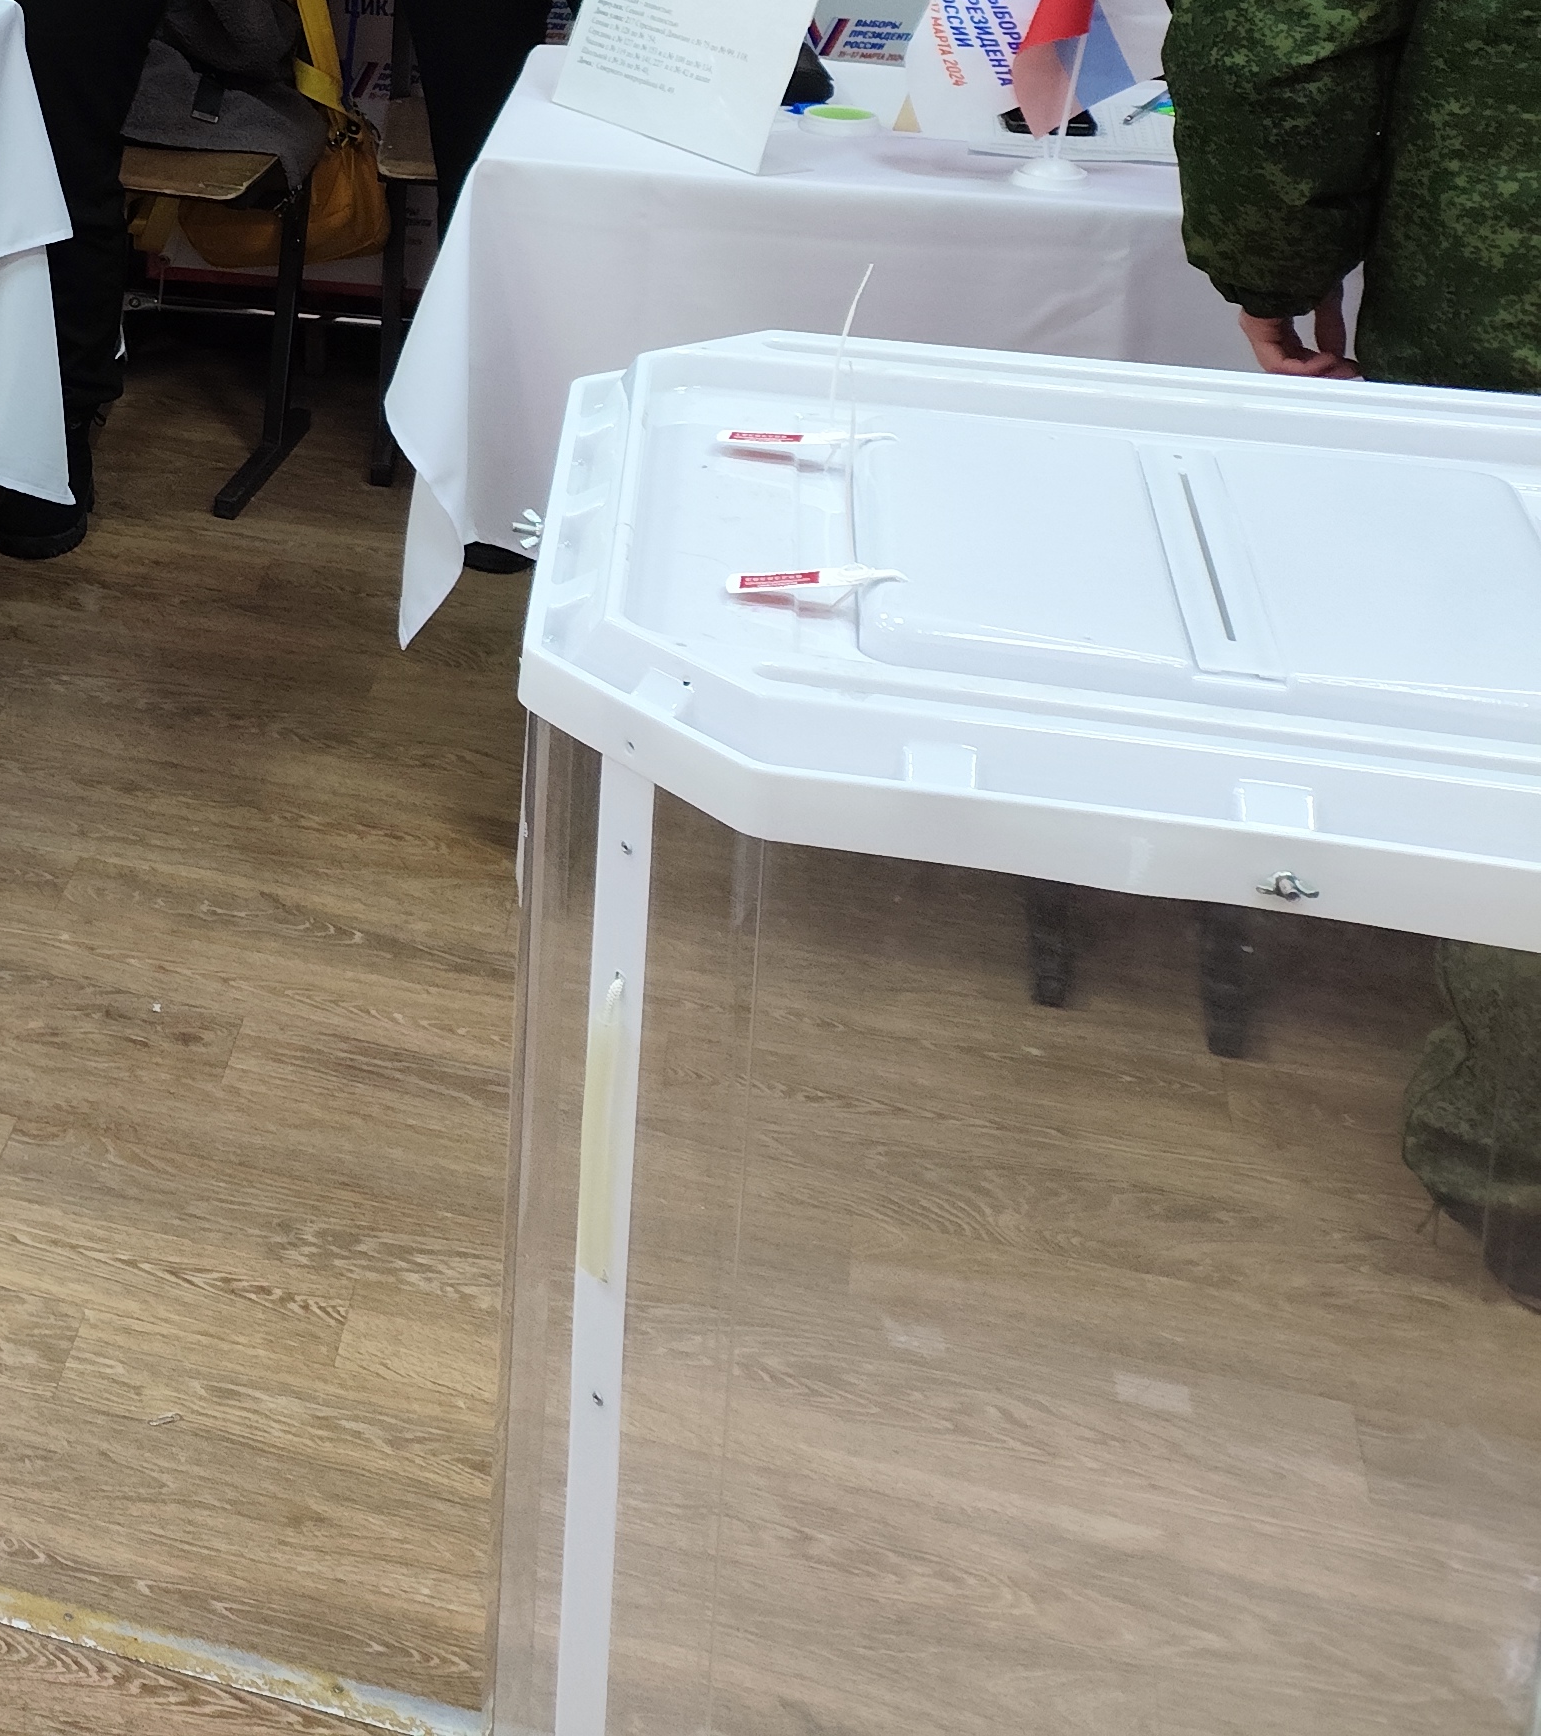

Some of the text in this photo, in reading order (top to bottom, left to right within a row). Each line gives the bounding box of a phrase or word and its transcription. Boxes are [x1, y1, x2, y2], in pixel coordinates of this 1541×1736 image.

[855, 19, 903, 29] ВЫБОРЫ
[843, 41, 886, 50] РОССИИ
[931, 16, 968, 86] МАРТА 2024
